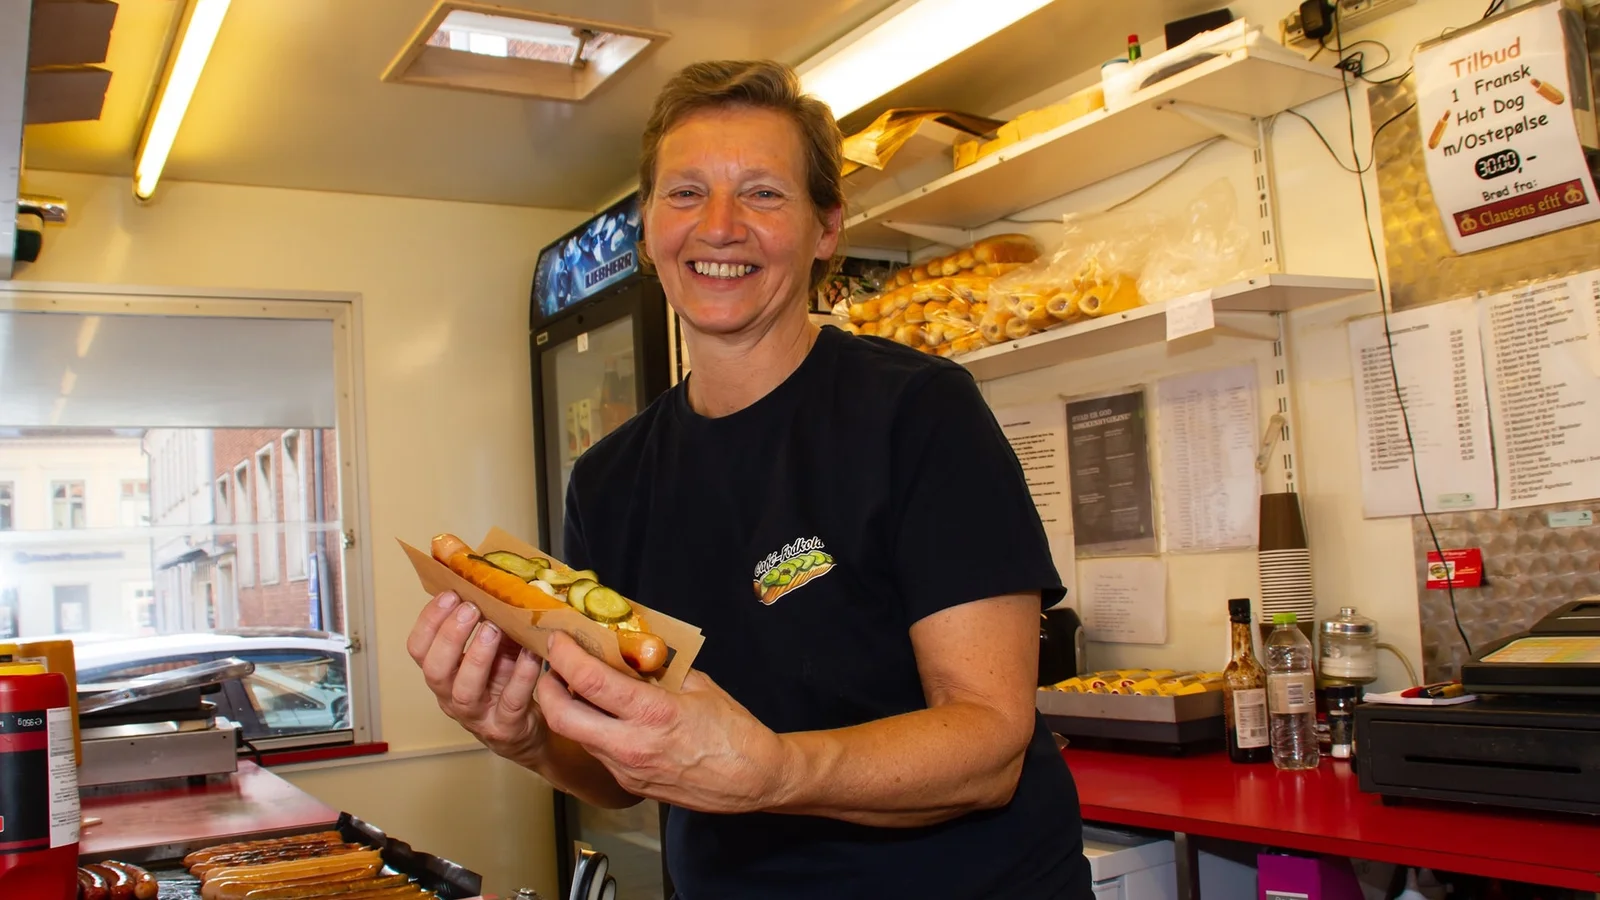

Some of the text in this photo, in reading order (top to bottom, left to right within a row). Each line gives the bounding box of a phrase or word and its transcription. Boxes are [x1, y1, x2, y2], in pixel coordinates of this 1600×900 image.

[1450, 36, 1521, 78] Tilbud
[1452, 64, 1531, 102] 1 Fransk
[1457, 95, 1524, 126] Hot Dog
[1443, 112, 1549, 157] m/Ostepølse
[1482, 186, 1510, 202] Brød
[1480, 204, 1535, 226] Clausens
[585, 252, 632, 289] LIEBHERR
